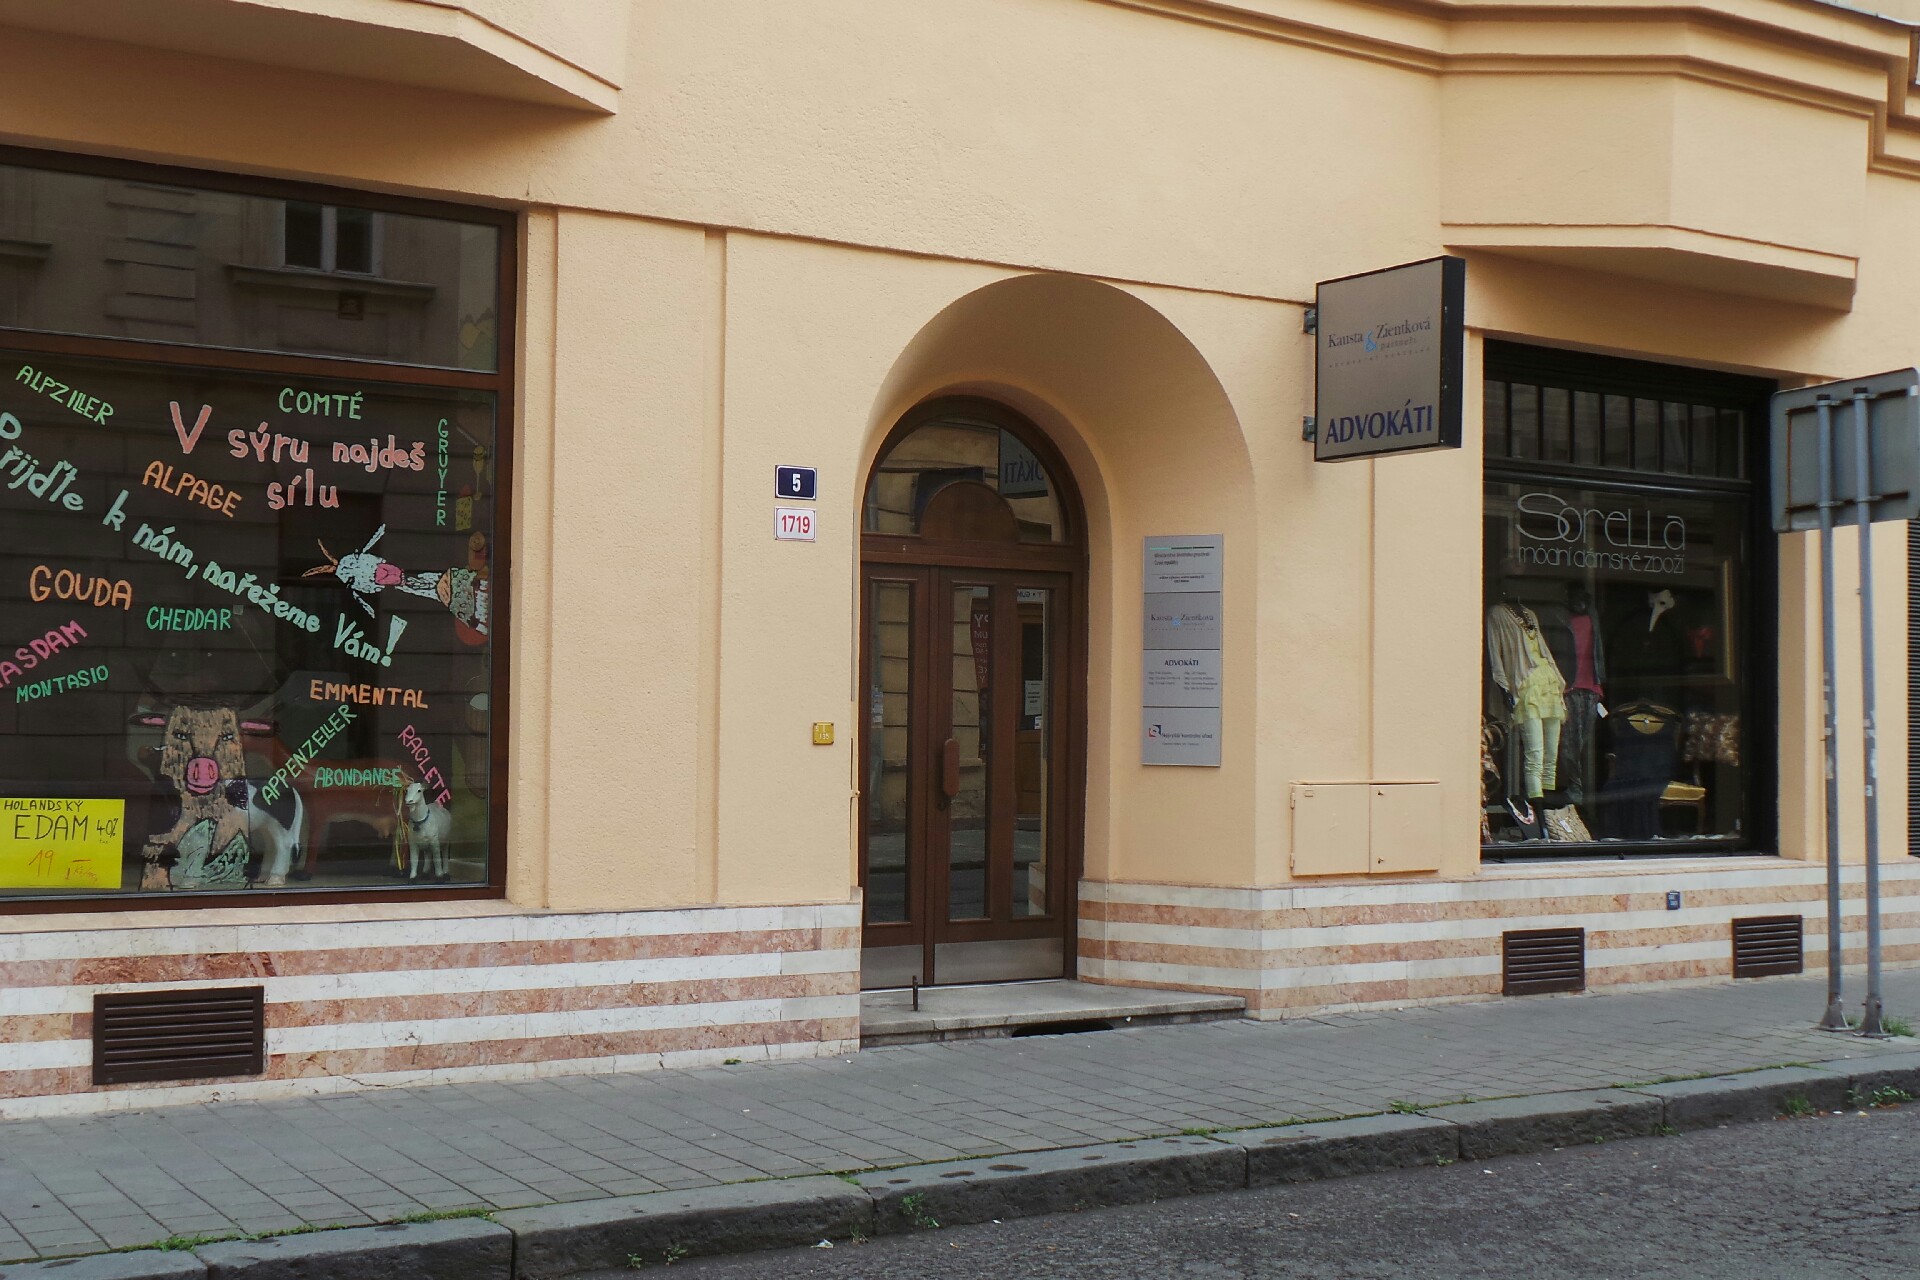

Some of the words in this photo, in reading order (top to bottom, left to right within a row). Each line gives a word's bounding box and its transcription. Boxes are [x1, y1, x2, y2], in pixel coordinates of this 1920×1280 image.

[1328, 332, 1364, 348] Kausta
[1376, 317, 1431, 339] Zientková
[278, 387, 364, 420] COMTÉ
[1325, 398, 1433, 444] ADVOKÁTI
[169, 401, 213, 454] V
[228, 421, 310, 463] sýru
[332, 434, 426, 472] najdeš
[142, 460, 242, 518] ALPAGE
[266, 468, 340, 510] sílu
[436, 418, 448, 526] GRUYER
[792, 473, 801, 492] 5
[781, 515, 811, 533] 1719
[102, 489, 129, 531] k
[202, 560, 320, 633] nařežeme
[333, 612, 407, 667] Vám!
[1518, 544, 1572, 567] módní
[1573, 547, 1642, 572] dámské
[1643, 553, 1686, 574] zboží
[30, 565, 132, 611] GOUDA
[146, 606, 232, 631] CHEDDAR
[0, 619, 88, 689] ASDAM
[1164, 657, 1199, 667] ADVOKÁTI
[16, 665, 109, 703] MONTASIO
[310, 679, 428, 709] EMMENTAL
[261, 704, 358, 806] APPENZELLER
[14, 814, 89, 841] EDAM
[96, 817, 119, 838] 40%
